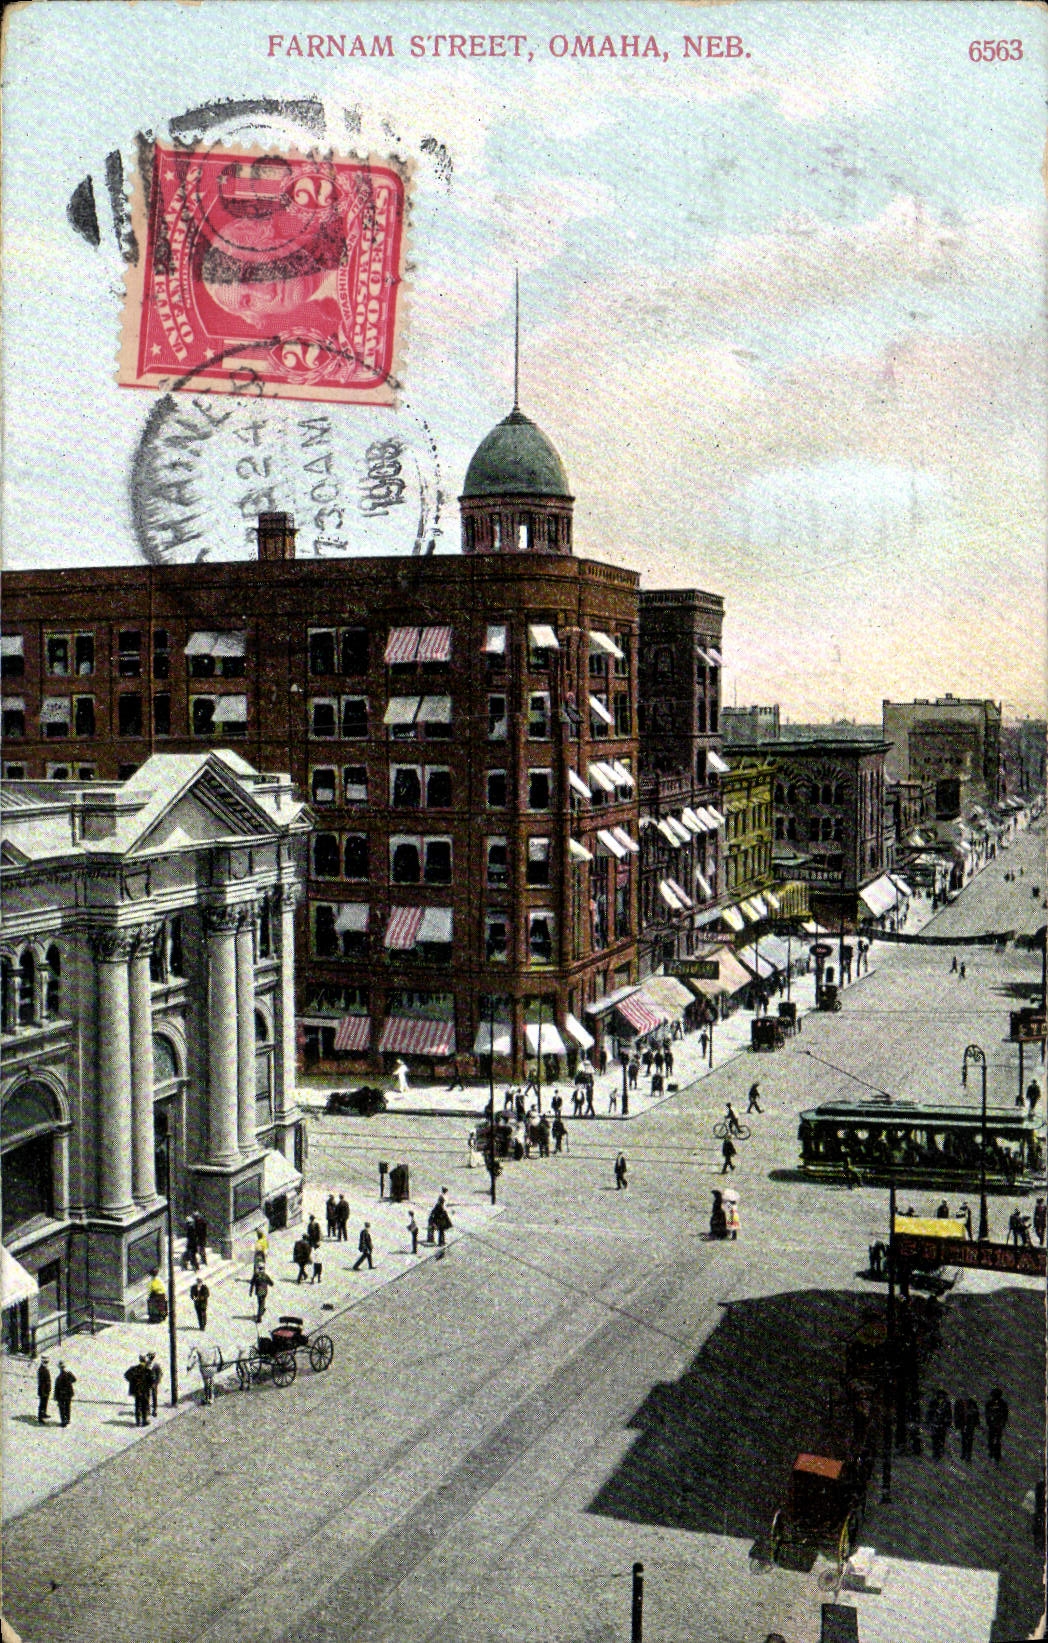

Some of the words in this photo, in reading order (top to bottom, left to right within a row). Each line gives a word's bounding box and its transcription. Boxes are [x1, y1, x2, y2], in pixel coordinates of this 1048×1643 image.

[154, 166, 202, 259] ATES
[294, 177, 333, 206] 2
[168, 190, 207, 308] AMERICA
[337, 233, 357, 321] WASHINON
[353, 207, 375, 345] POSTAGE
[368, 187, 389, 296] CENTS
[175, 309, 194, 344] OF
[282, 343, 321, 369] 2
[364, 299, 380, 368] TWO
